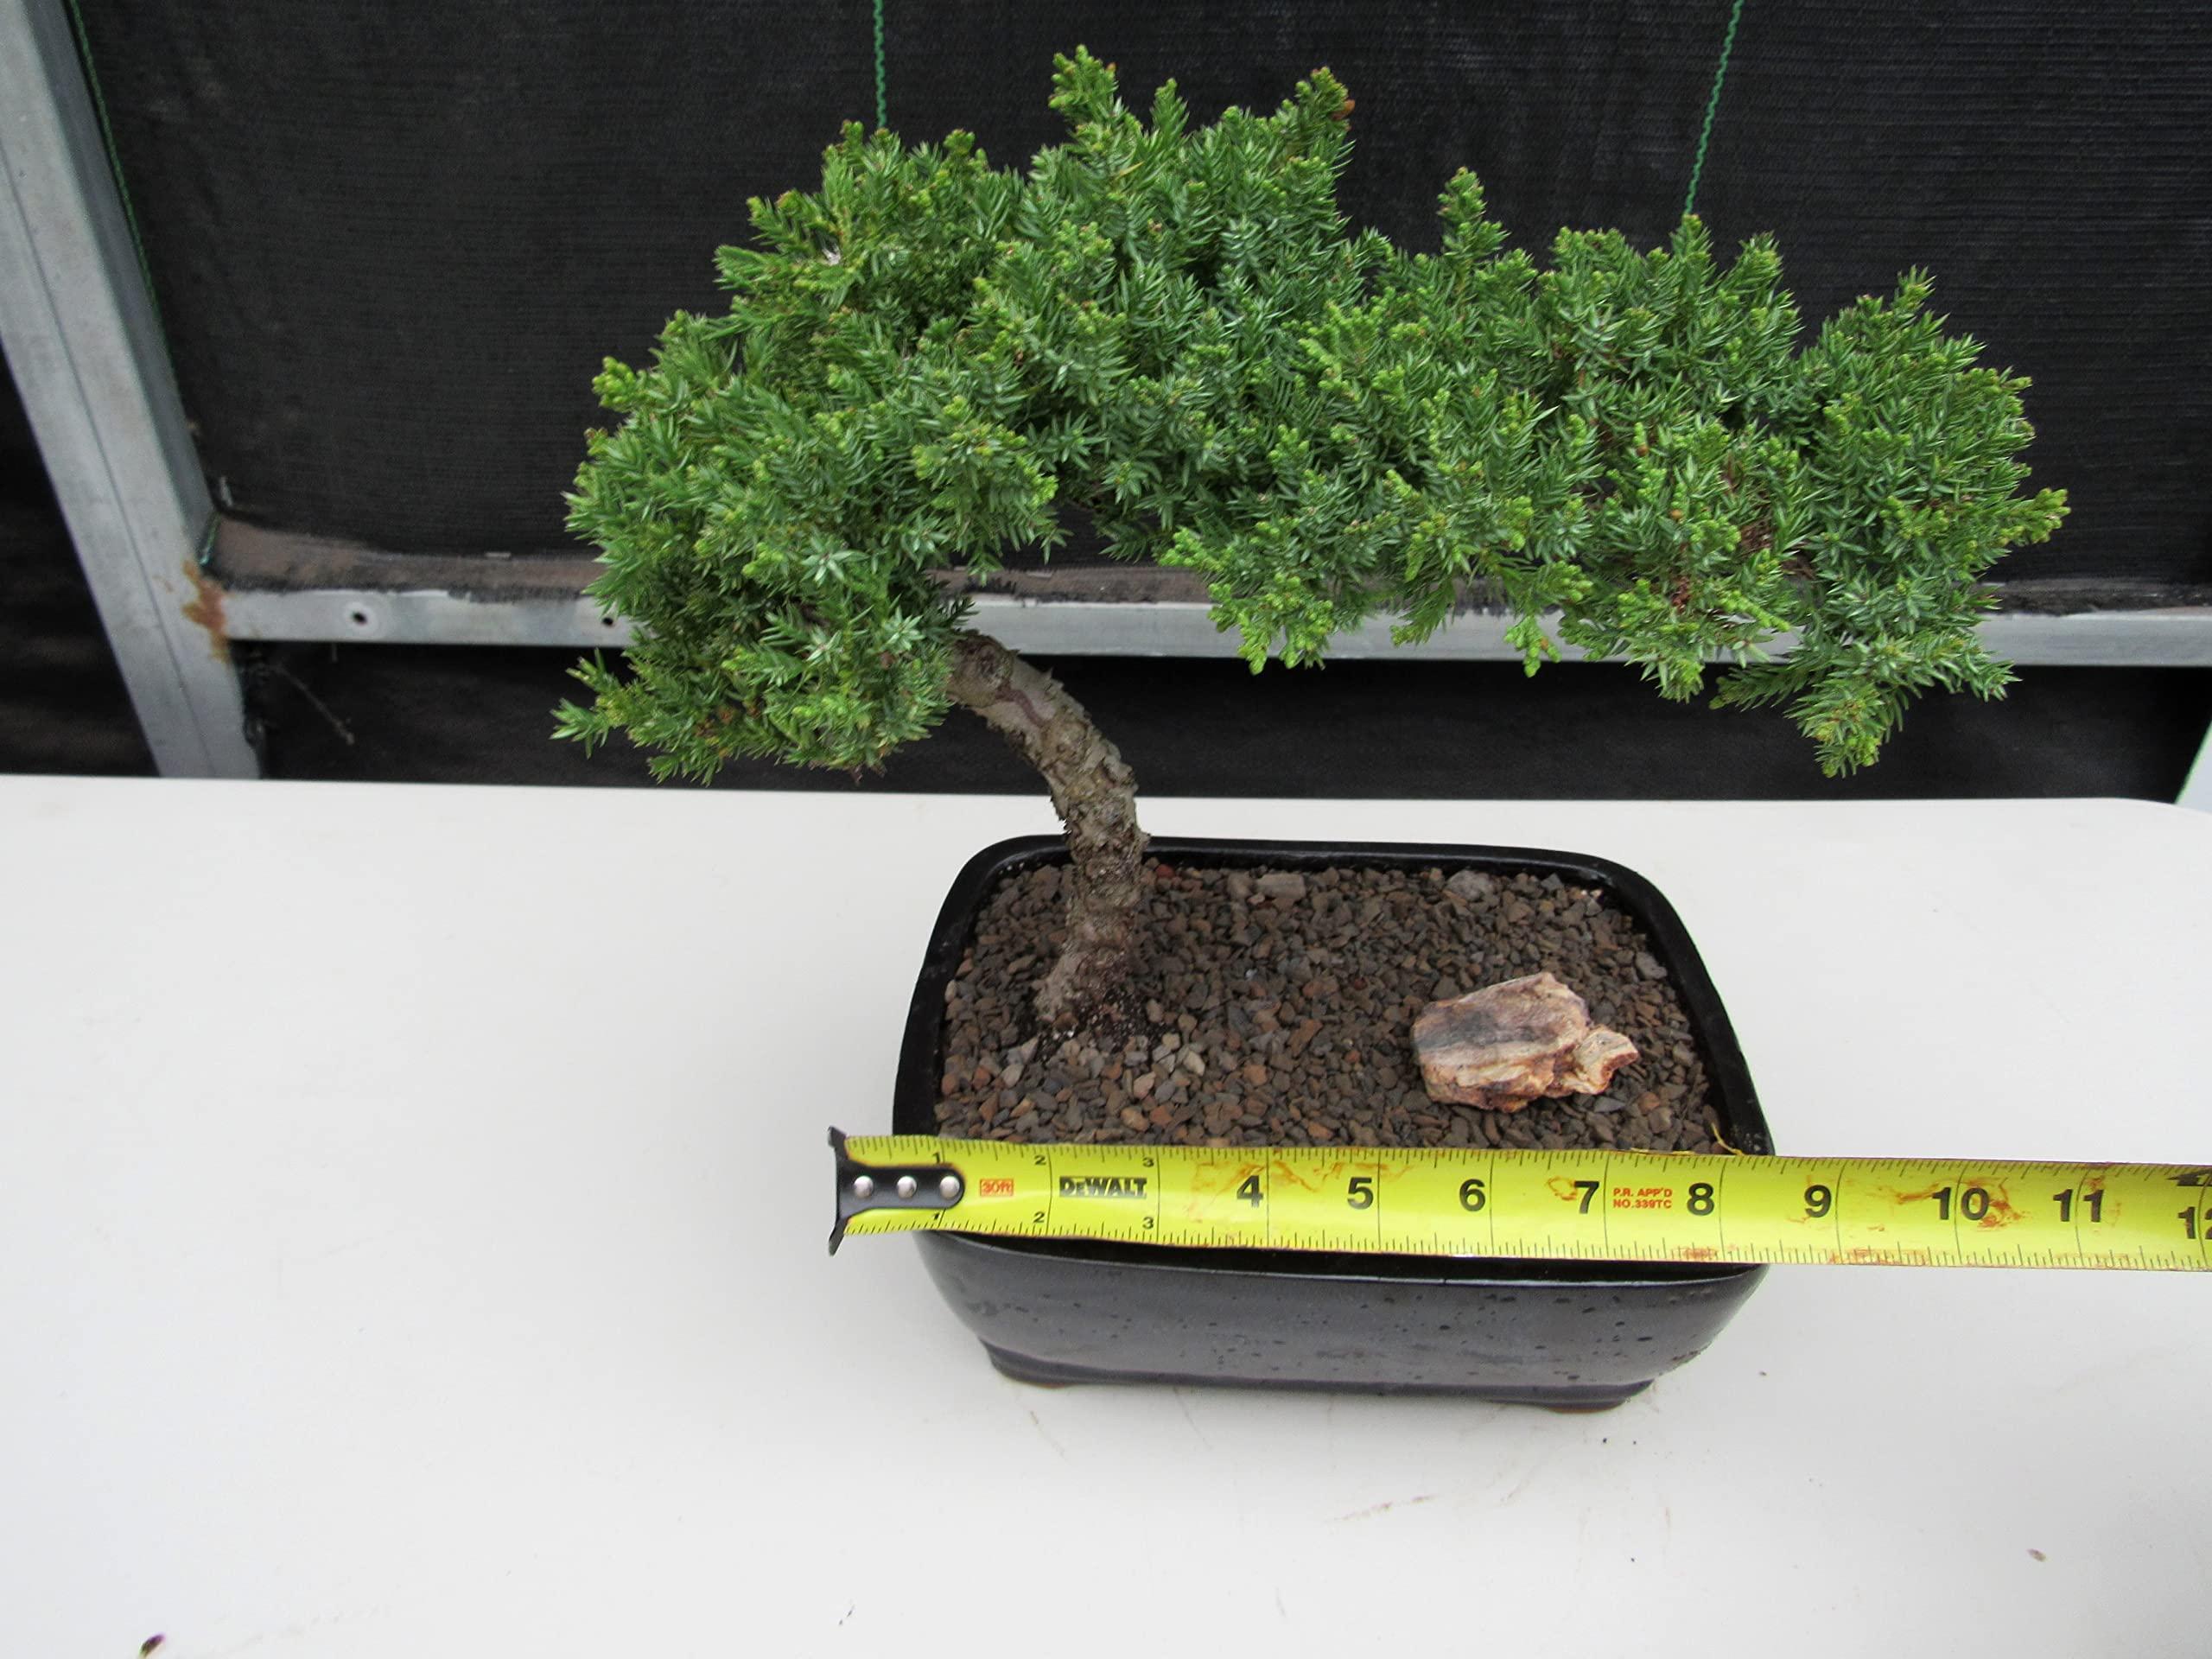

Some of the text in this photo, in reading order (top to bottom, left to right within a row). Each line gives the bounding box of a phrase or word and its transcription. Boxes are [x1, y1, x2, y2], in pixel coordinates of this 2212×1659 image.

[1034, 1155, 1046, 1166] 2
[1142, 1157, 1154, 1167] 3
[1236, 1176, 1264, 1208] 4
[1347, 1177, 1374, 1210] 5
[1459, 1179, 1486, 1212] 6
[1574, 1180, 1599, 1214] 7
[1637, 1187, 1672, 1198] APP'D
[1687, 1182, 1715, 1217] 8
[1804, 1185, 1832, 1218] 9
[1931, 1186, 1990, 1222] 10
[2053, 1188, 2105, 1223] 11
[1033, 1211, 1046, 1224] 2
[1142, 1217, 1154, 1230] 3
